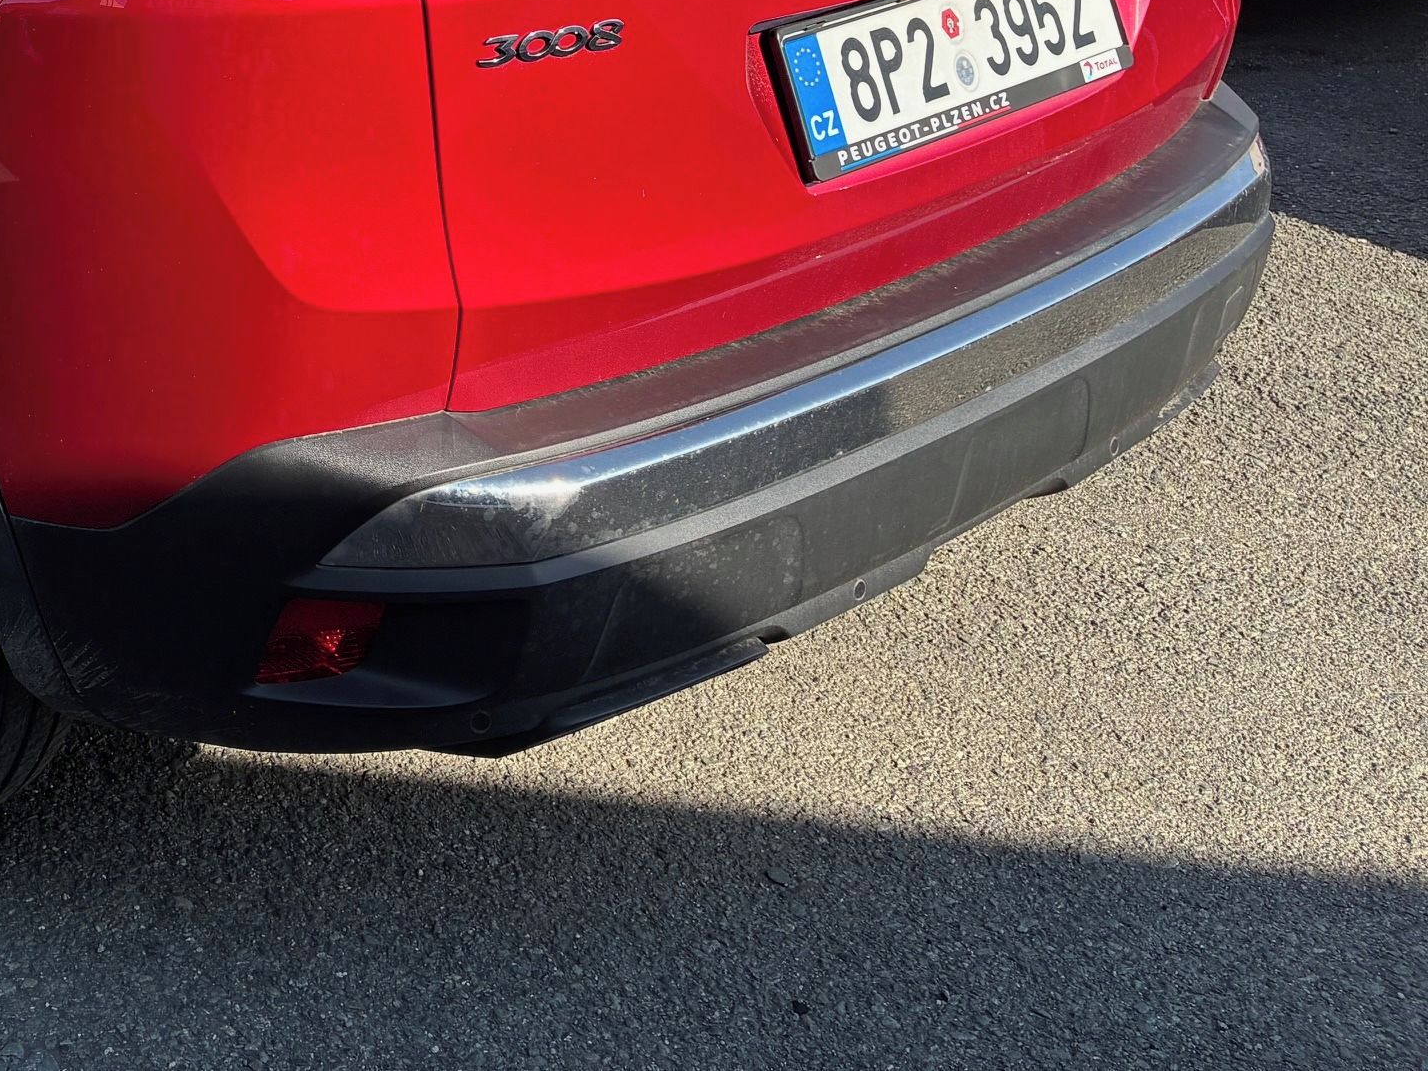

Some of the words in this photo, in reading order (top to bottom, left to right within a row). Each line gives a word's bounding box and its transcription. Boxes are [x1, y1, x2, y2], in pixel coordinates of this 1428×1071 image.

[476, 18, 625, 68] 3008
[840, 16, 951, 123] 8P2
[810, 110, 840, 142] CZ
[837, 91, 1011, 167] PEUGEOT-PLZEN.CZ
